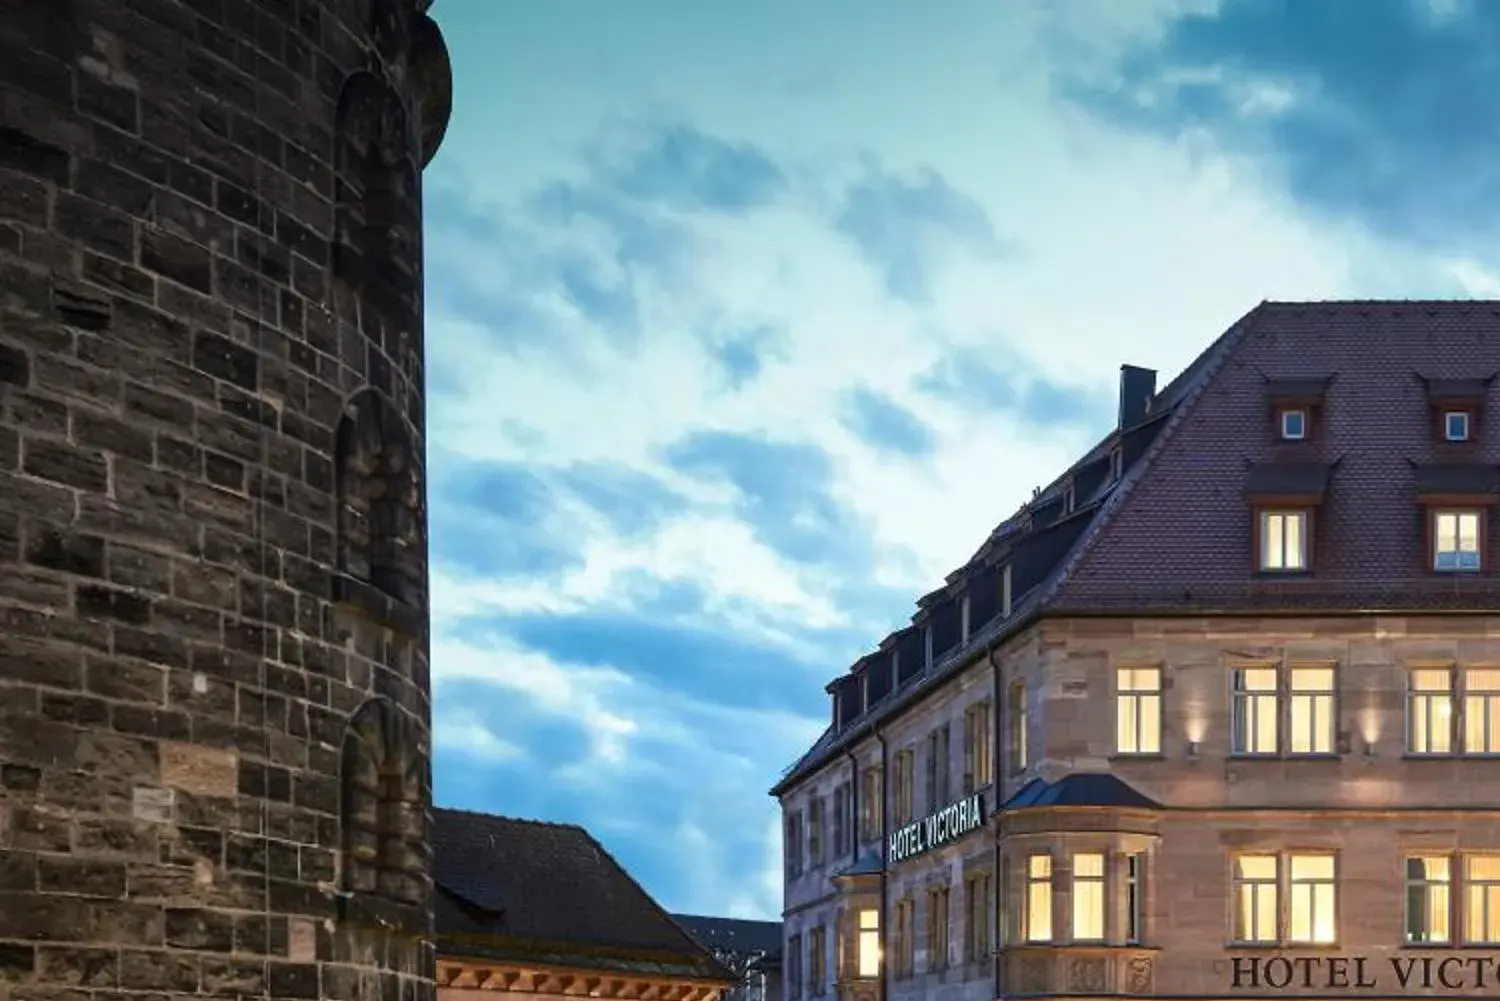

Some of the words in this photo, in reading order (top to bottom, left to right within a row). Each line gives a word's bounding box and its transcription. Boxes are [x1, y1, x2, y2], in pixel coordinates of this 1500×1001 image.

[888, 821, 924, 863] HOTEL
[925, 794, 982, 849] VICTORIA
[1230, 956, 1377, 989] HOTEL
